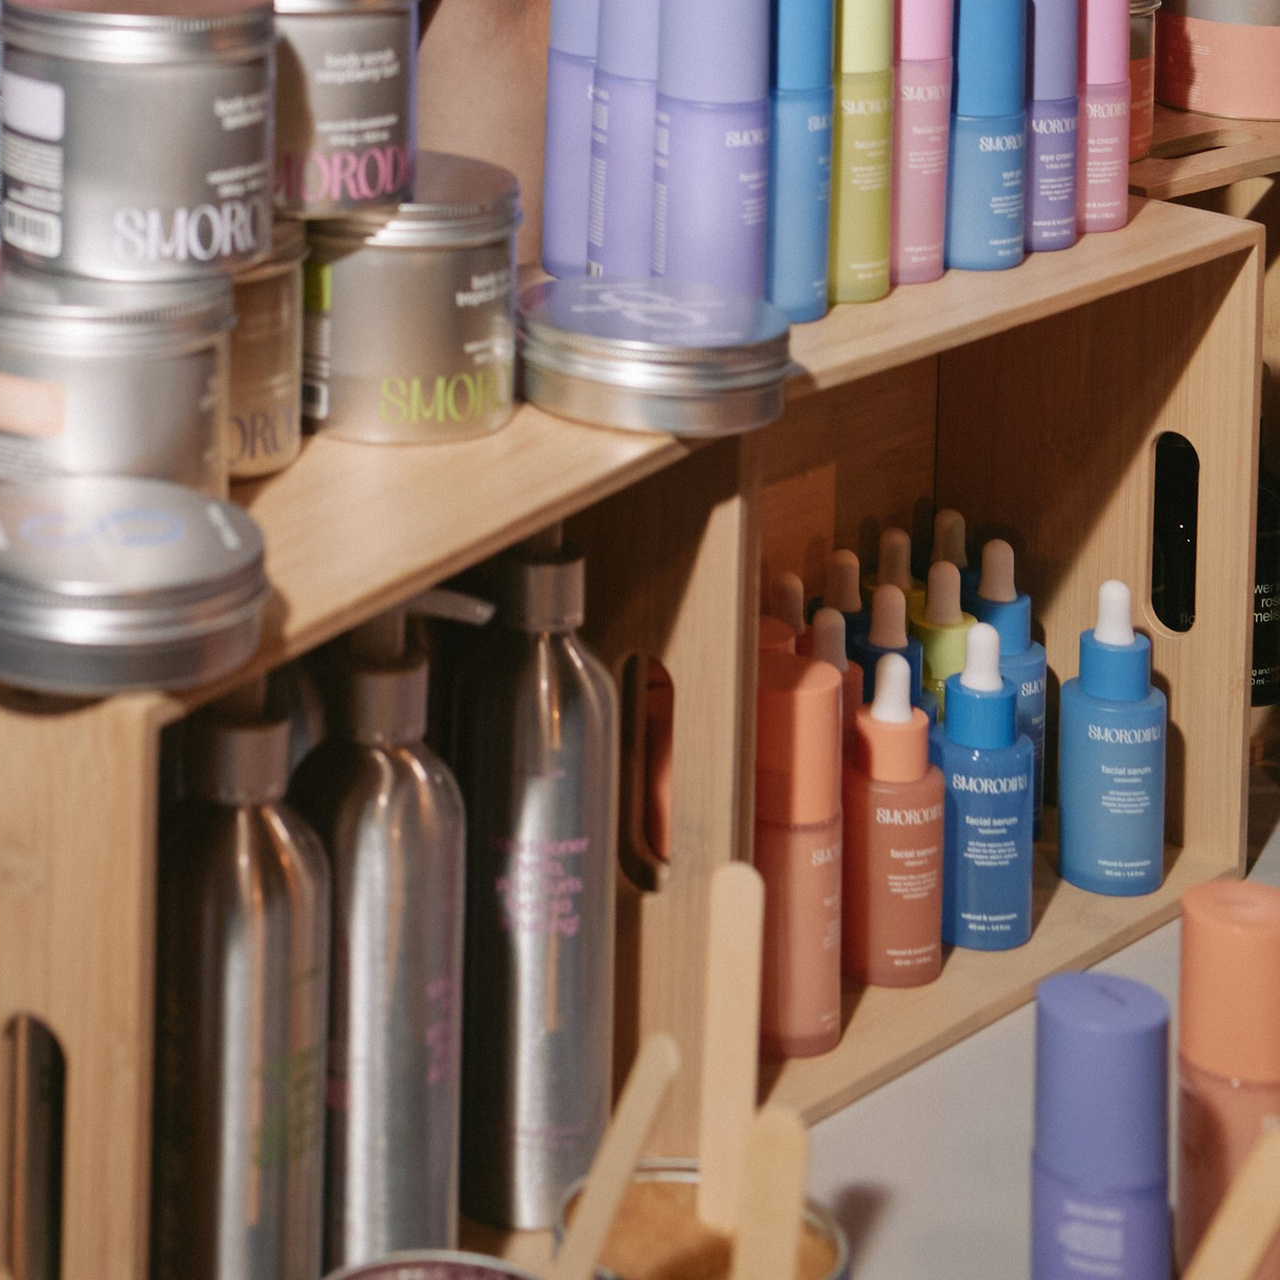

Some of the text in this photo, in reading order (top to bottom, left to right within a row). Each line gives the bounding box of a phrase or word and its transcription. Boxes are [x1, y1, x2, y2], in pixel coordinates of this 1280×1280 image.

[1254, 582, 1273, 594] wer
[1101, 765, 1151, 776] facial serum
[966, 815, 1018, 827] facial serum
[890, 848, 915, 858] facial
